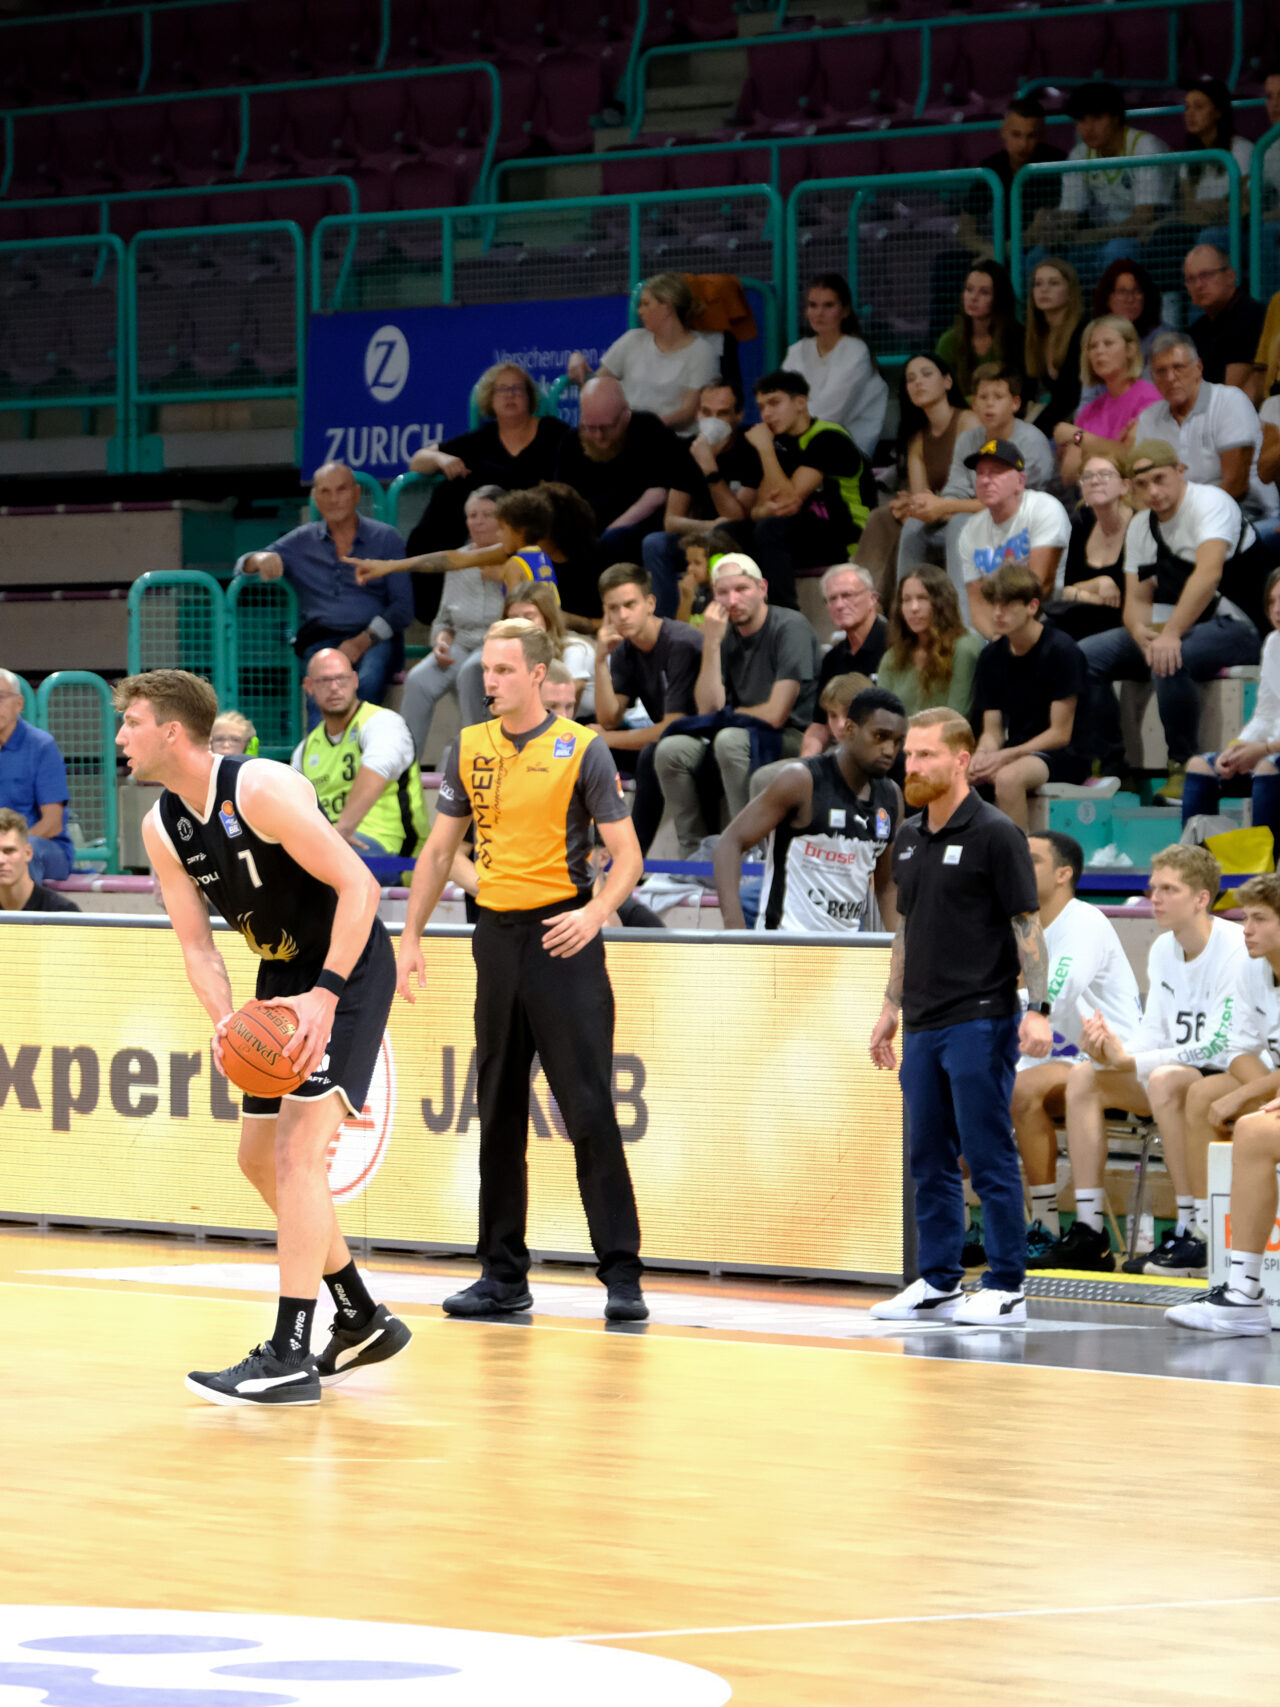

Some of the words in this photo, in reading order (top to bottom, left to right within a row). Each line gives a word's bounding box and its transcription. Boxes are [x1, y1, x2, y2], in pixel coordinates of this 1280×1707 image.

[495, 346, 599, 370] Versicherunen
[324, 423, 444, 466] ZURICH
[342, 753, 356, 781] 3
[803, 840, 856, 865] brose
[237, 848, 263, 889] 7
[334, 1283, 352, 1307] CRAFT
[293, 1310, 307, 1340] CRAFT
